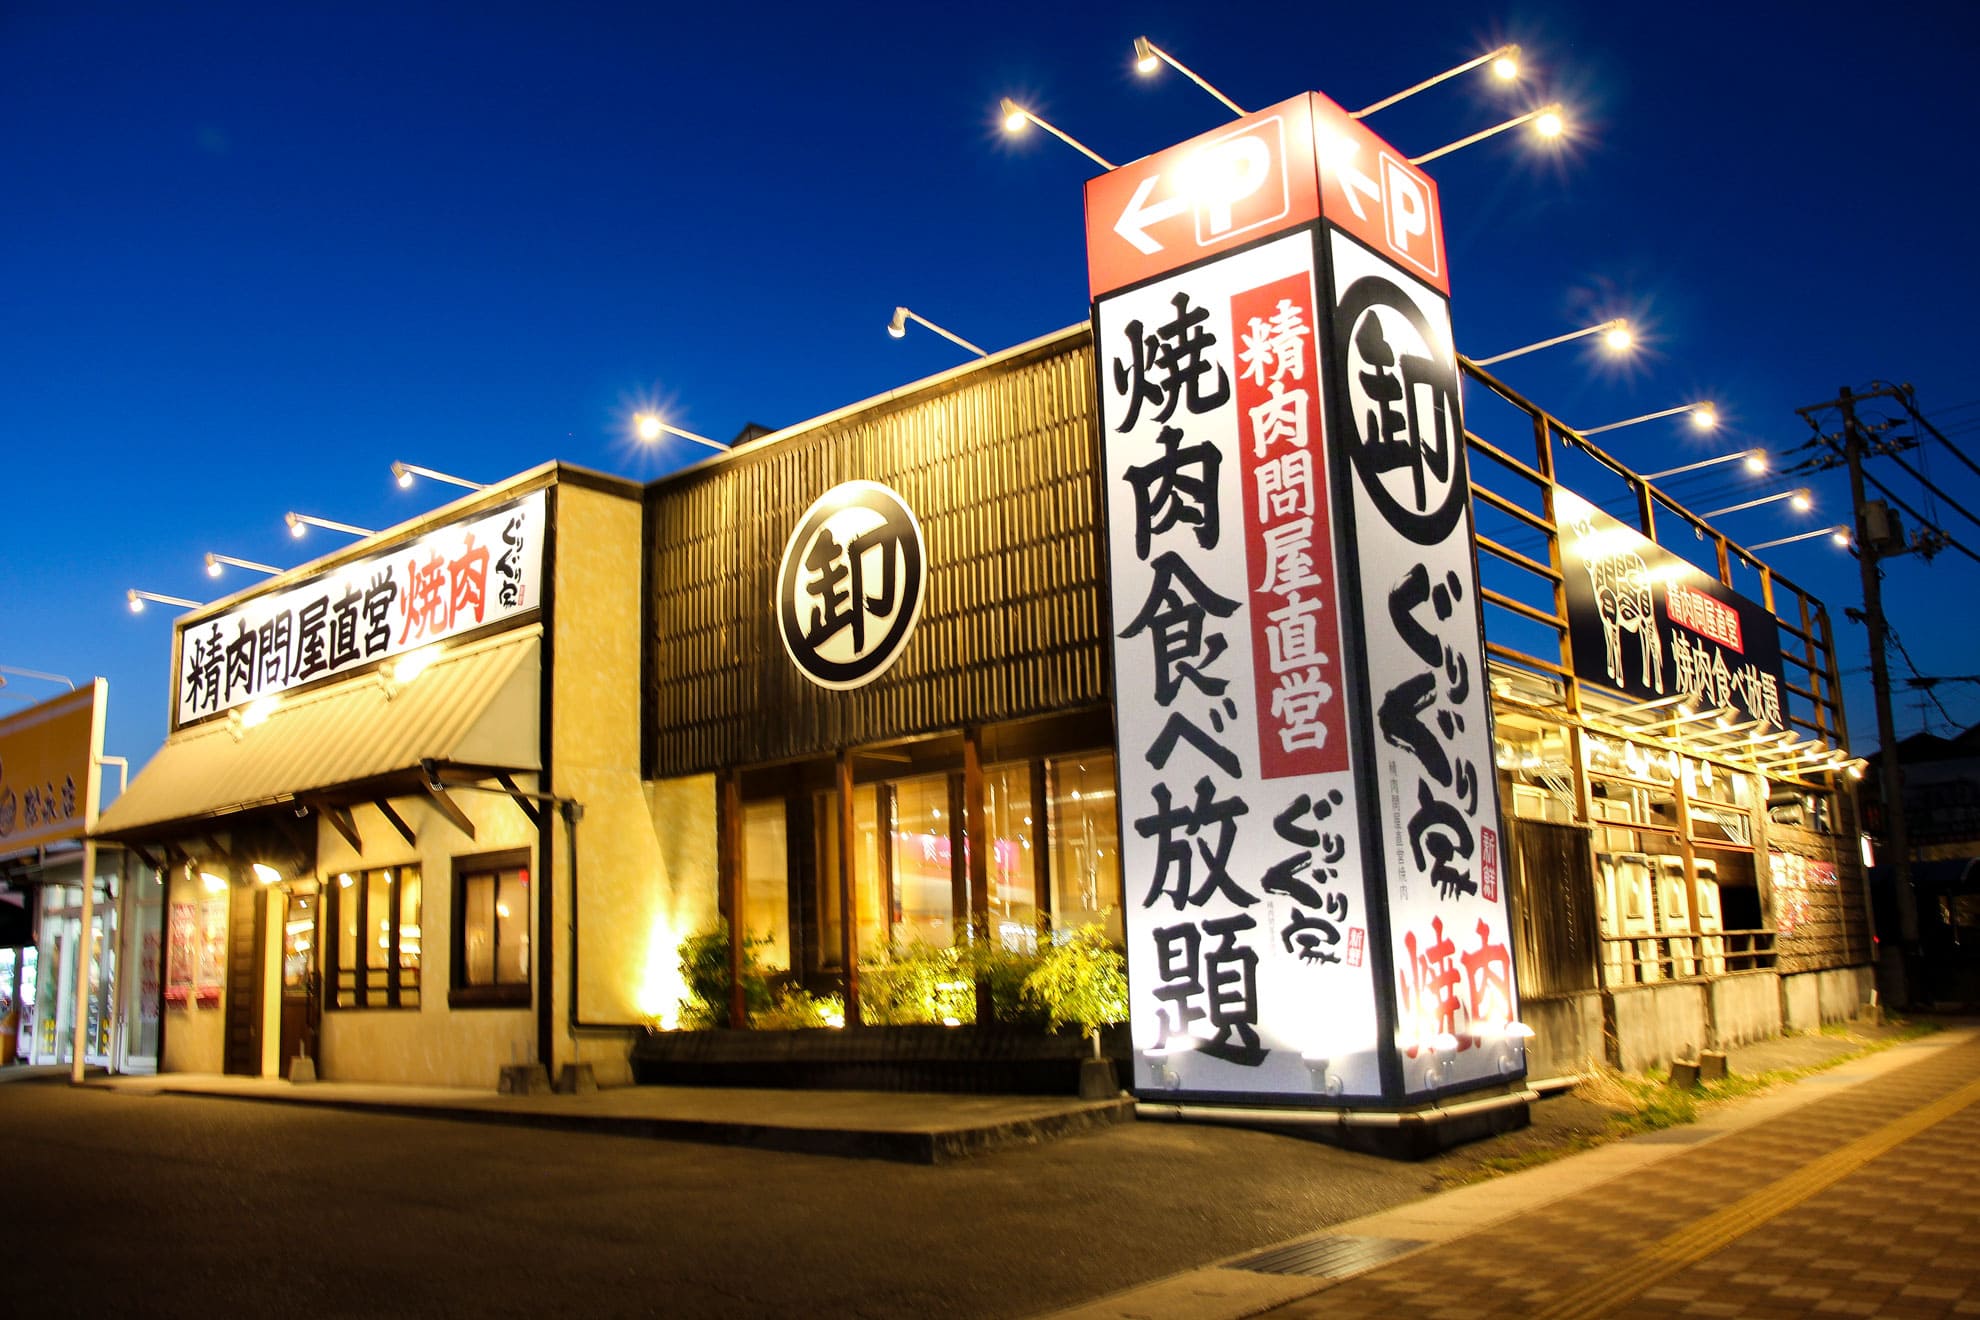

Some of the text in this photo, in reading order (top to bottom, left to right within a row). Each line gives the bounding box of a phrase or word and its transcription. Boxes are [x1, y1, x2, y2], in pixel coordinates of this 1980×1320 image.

[1204, 134, 1271, 234] P
[1389, 167, 1427, 252] P
[1348, 309, 1450, 512] 卸
[1240, 299, 1333, 752] 精肉問屋直営
[803, 526, 903, 657] 卸
[1666, 577, 1740, 649] 精肉問屋直営
[1113, 291, 1271, 1067] 焼肉食べ放題
[1670, 627, 1784, 731] 焼肉食べ放題
[1400, 915, 1514, 1060] 焼肉
